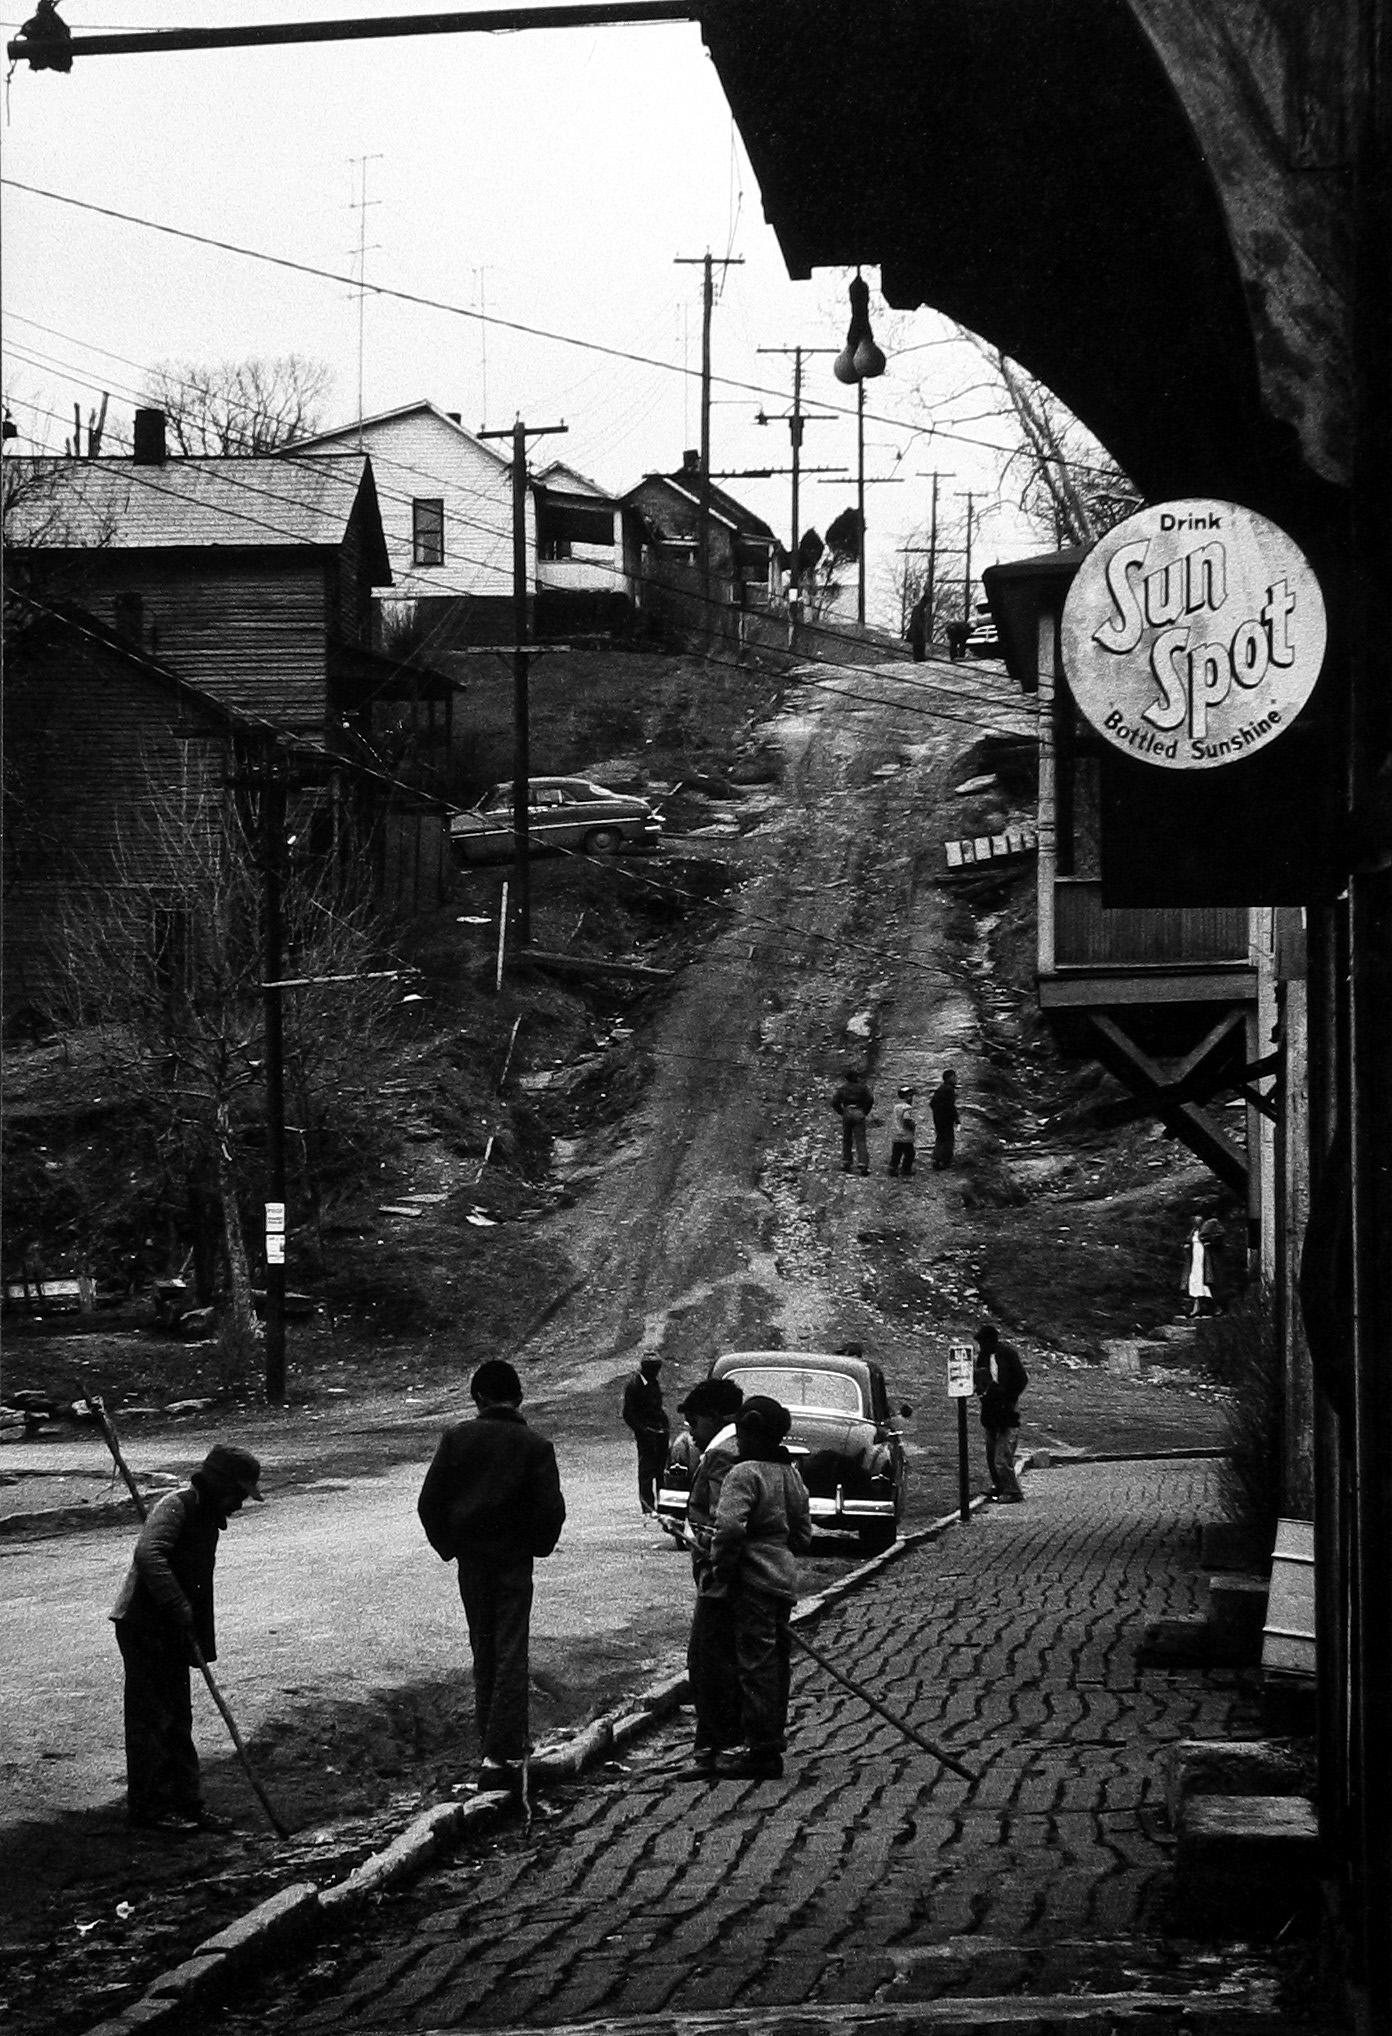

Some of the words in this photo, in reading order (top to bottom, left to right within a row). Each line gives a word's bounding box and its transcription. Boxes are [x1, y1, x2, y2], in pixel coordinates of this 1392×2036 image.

[1160, 512, 1223, 531] Drink
[1092, 538, 1229, 655] Sun
[1141, 579, 1296, 739] Spot
[1104, 710, 1178, 759] Bottled
[1191, 710, 1282, 760] Sunshine
